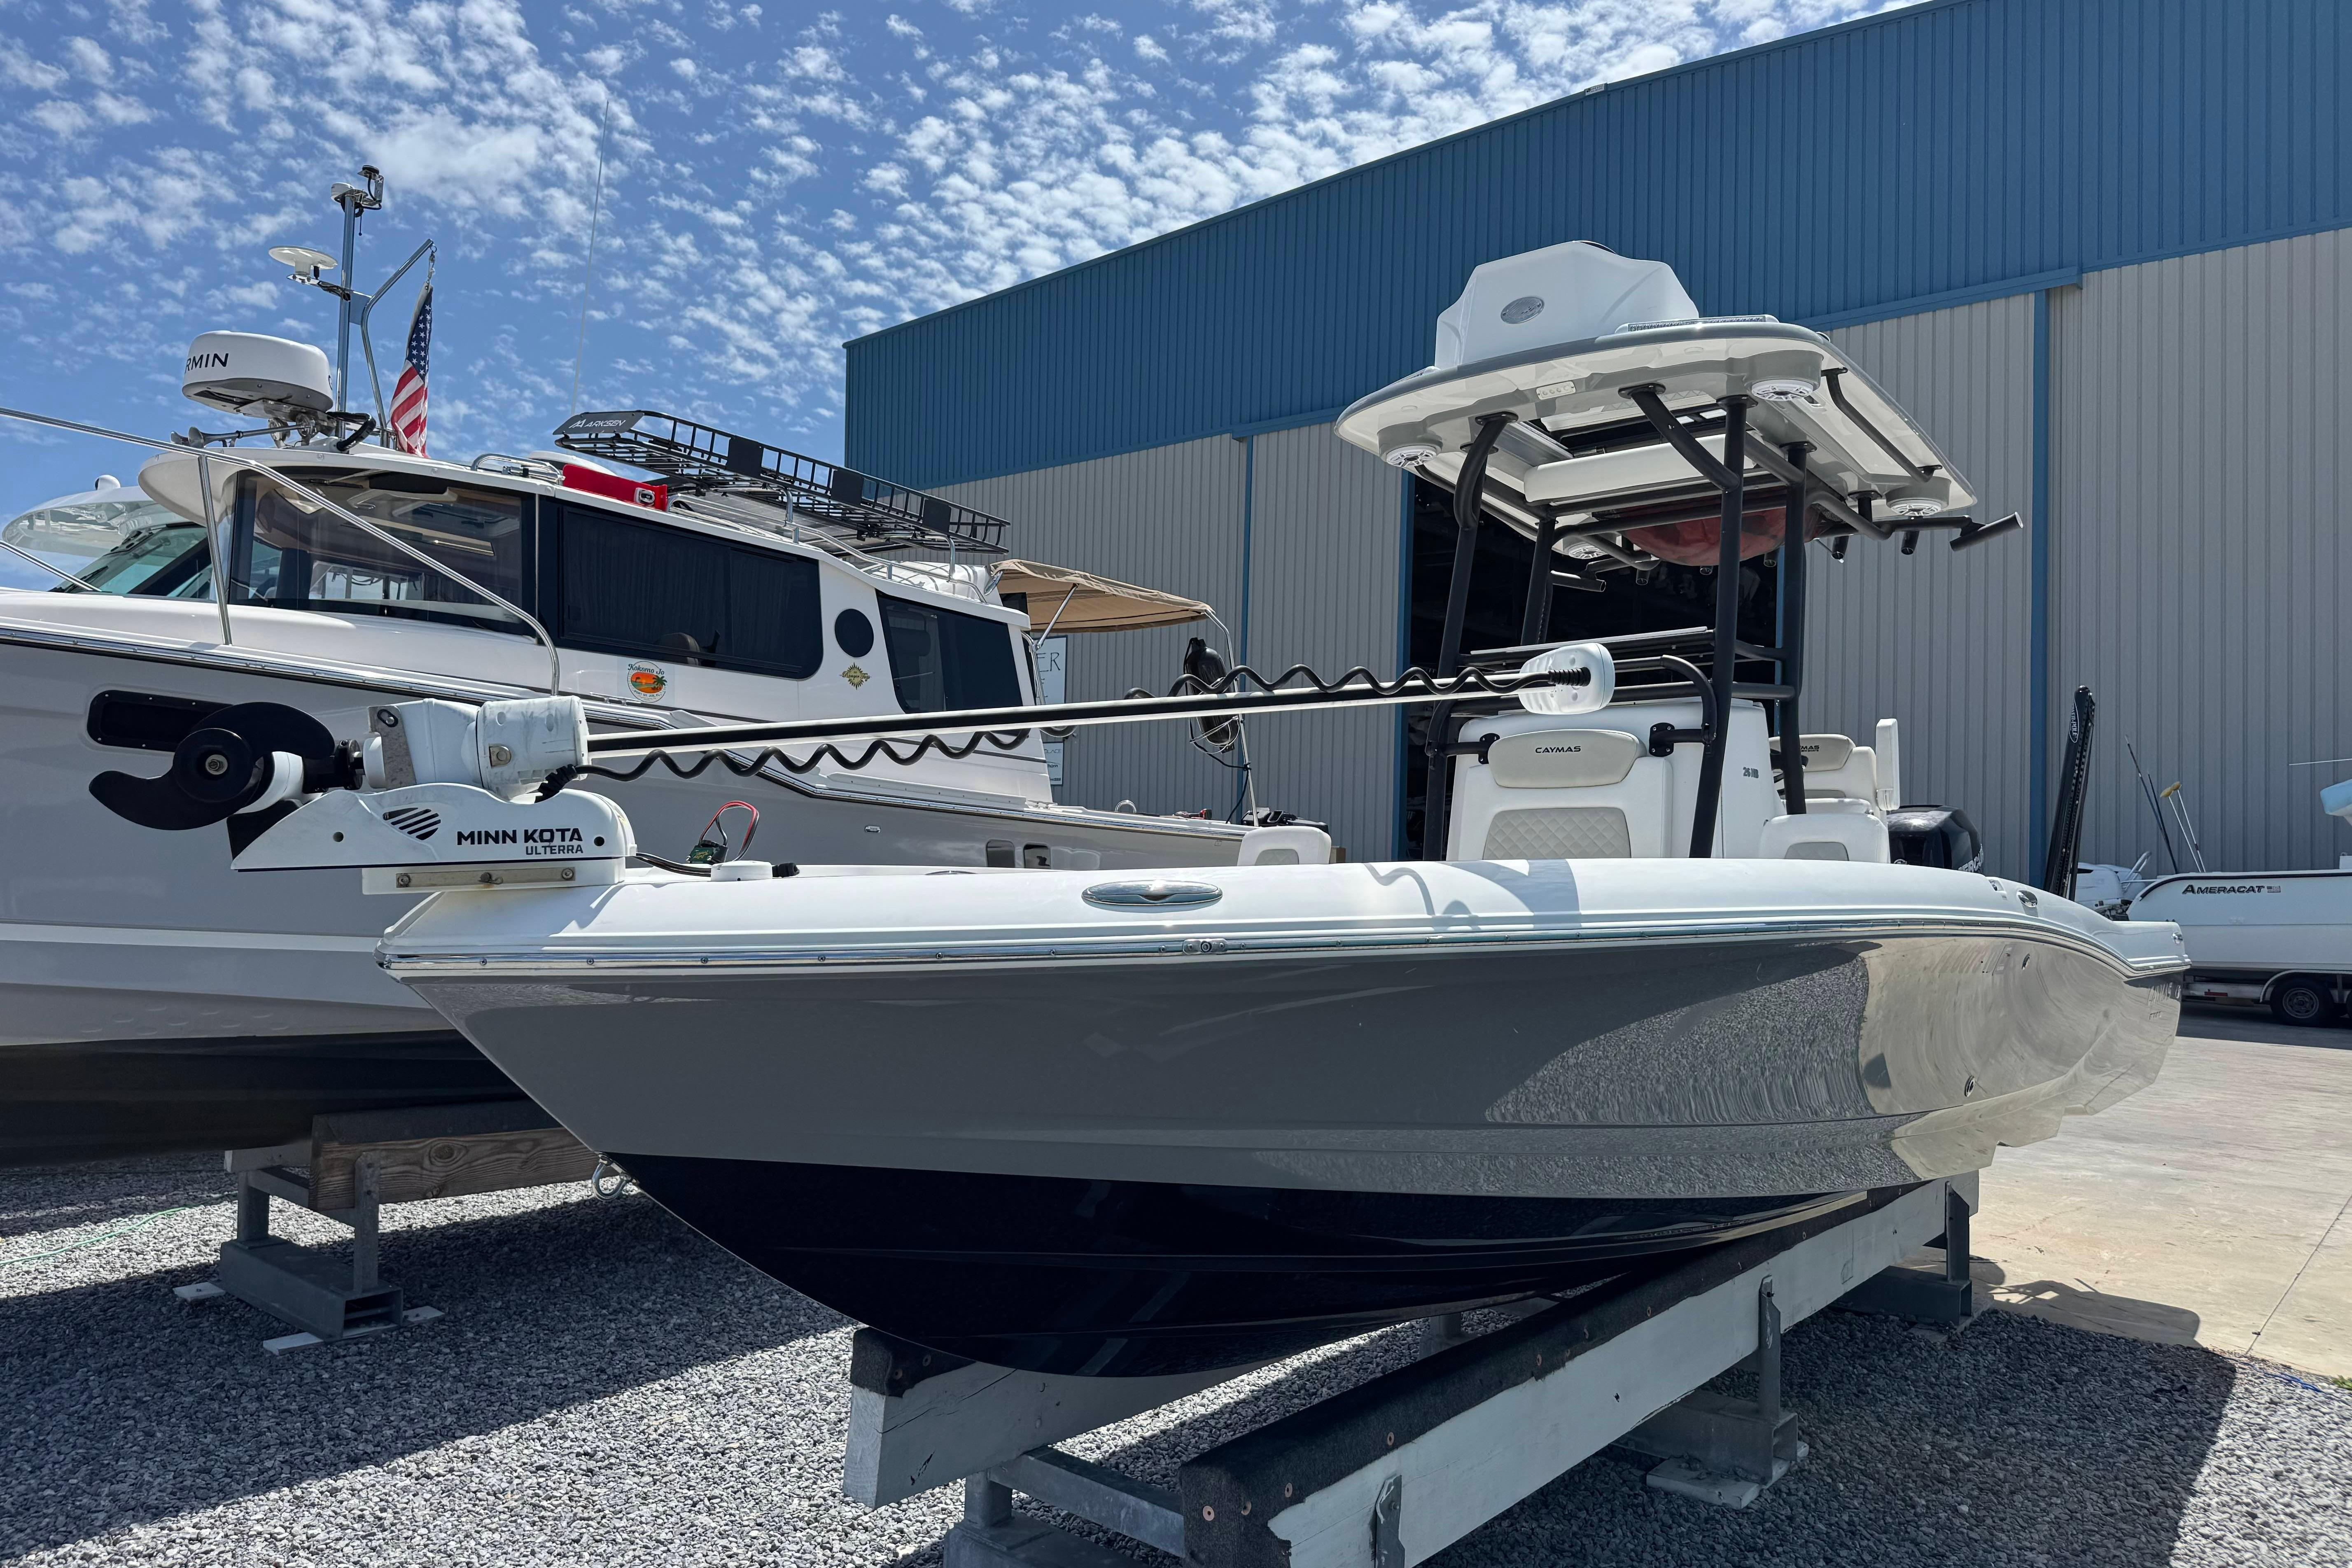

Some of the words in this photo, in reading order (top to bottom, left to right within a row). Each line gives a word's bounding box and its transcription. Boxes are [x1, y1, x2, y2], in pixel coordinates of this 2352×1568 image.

[628, 663, 655, 673] Kokomo
[457, 829, 517, 845] MINN
[524, 828, 583, 843] KOTA
[525, 844, 584, 855] ULTERRA
[2182, 884, 2265, 894] AMERACAT
